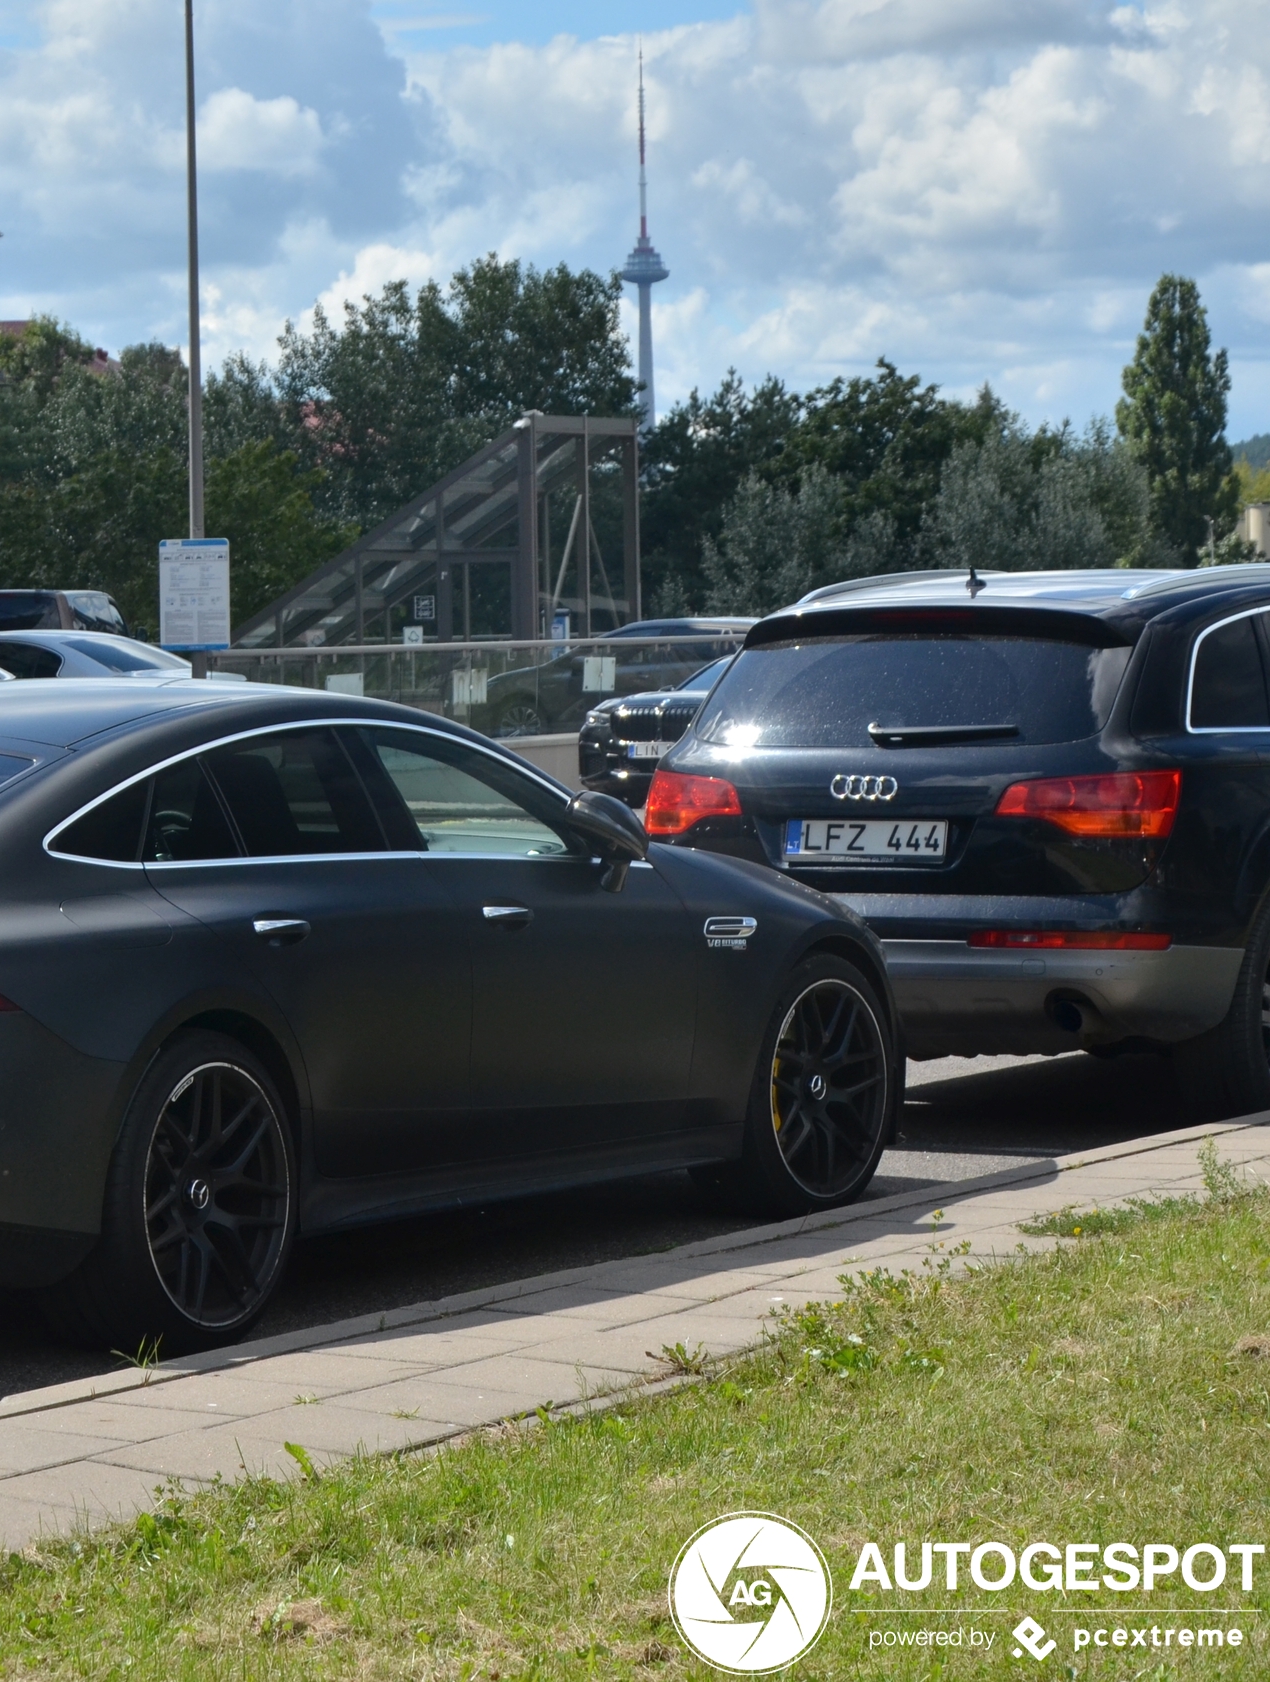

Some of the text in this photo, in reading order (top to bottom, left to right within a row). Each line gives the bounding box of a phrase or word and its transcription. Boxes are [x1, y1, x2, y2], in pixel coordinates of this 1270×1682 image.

[635, 744, 659, 756] LIN
[787, 823, 940, 852] LT LFZ 444
[707, 939, 721, 948] V8
